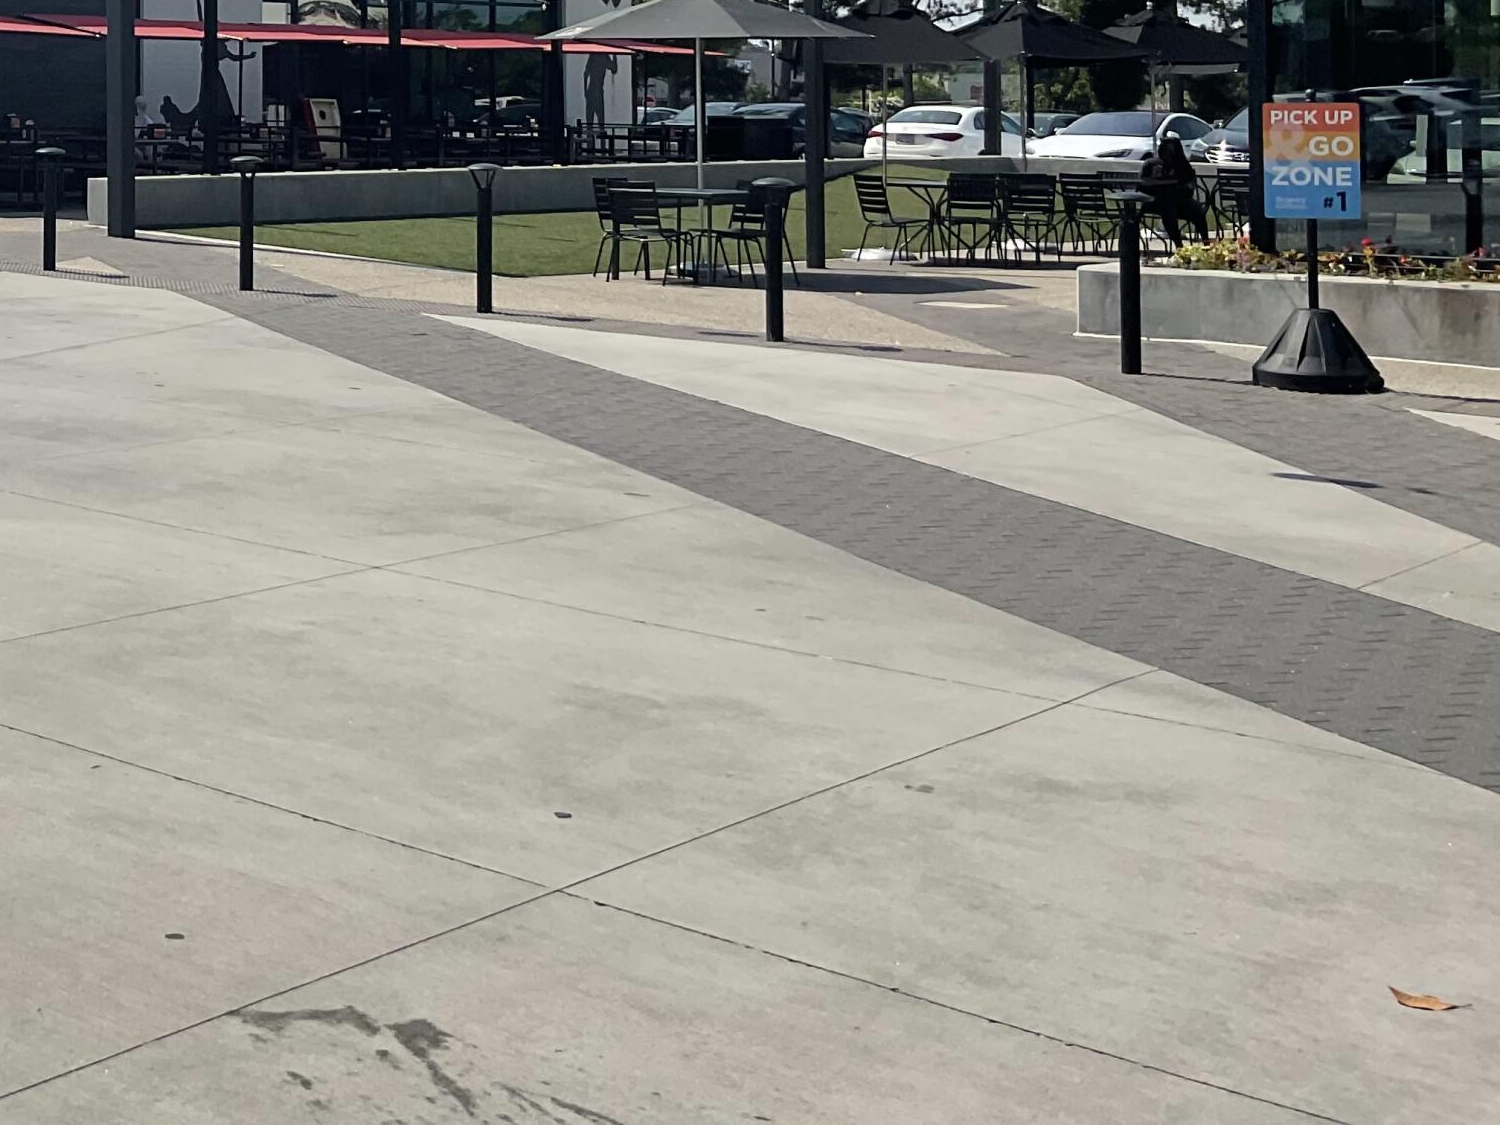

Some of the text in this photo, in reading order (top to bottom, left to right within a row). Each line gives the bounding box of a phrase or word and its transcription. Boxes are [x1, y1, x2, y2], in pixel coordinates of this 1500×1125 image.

[1270, 110, 1352, 125] PICK UP
[1308, 136, 1354, 156] GO
[1271, 166, 1353, 187] ZONE
[1323, 191, 1347, 212] #1
